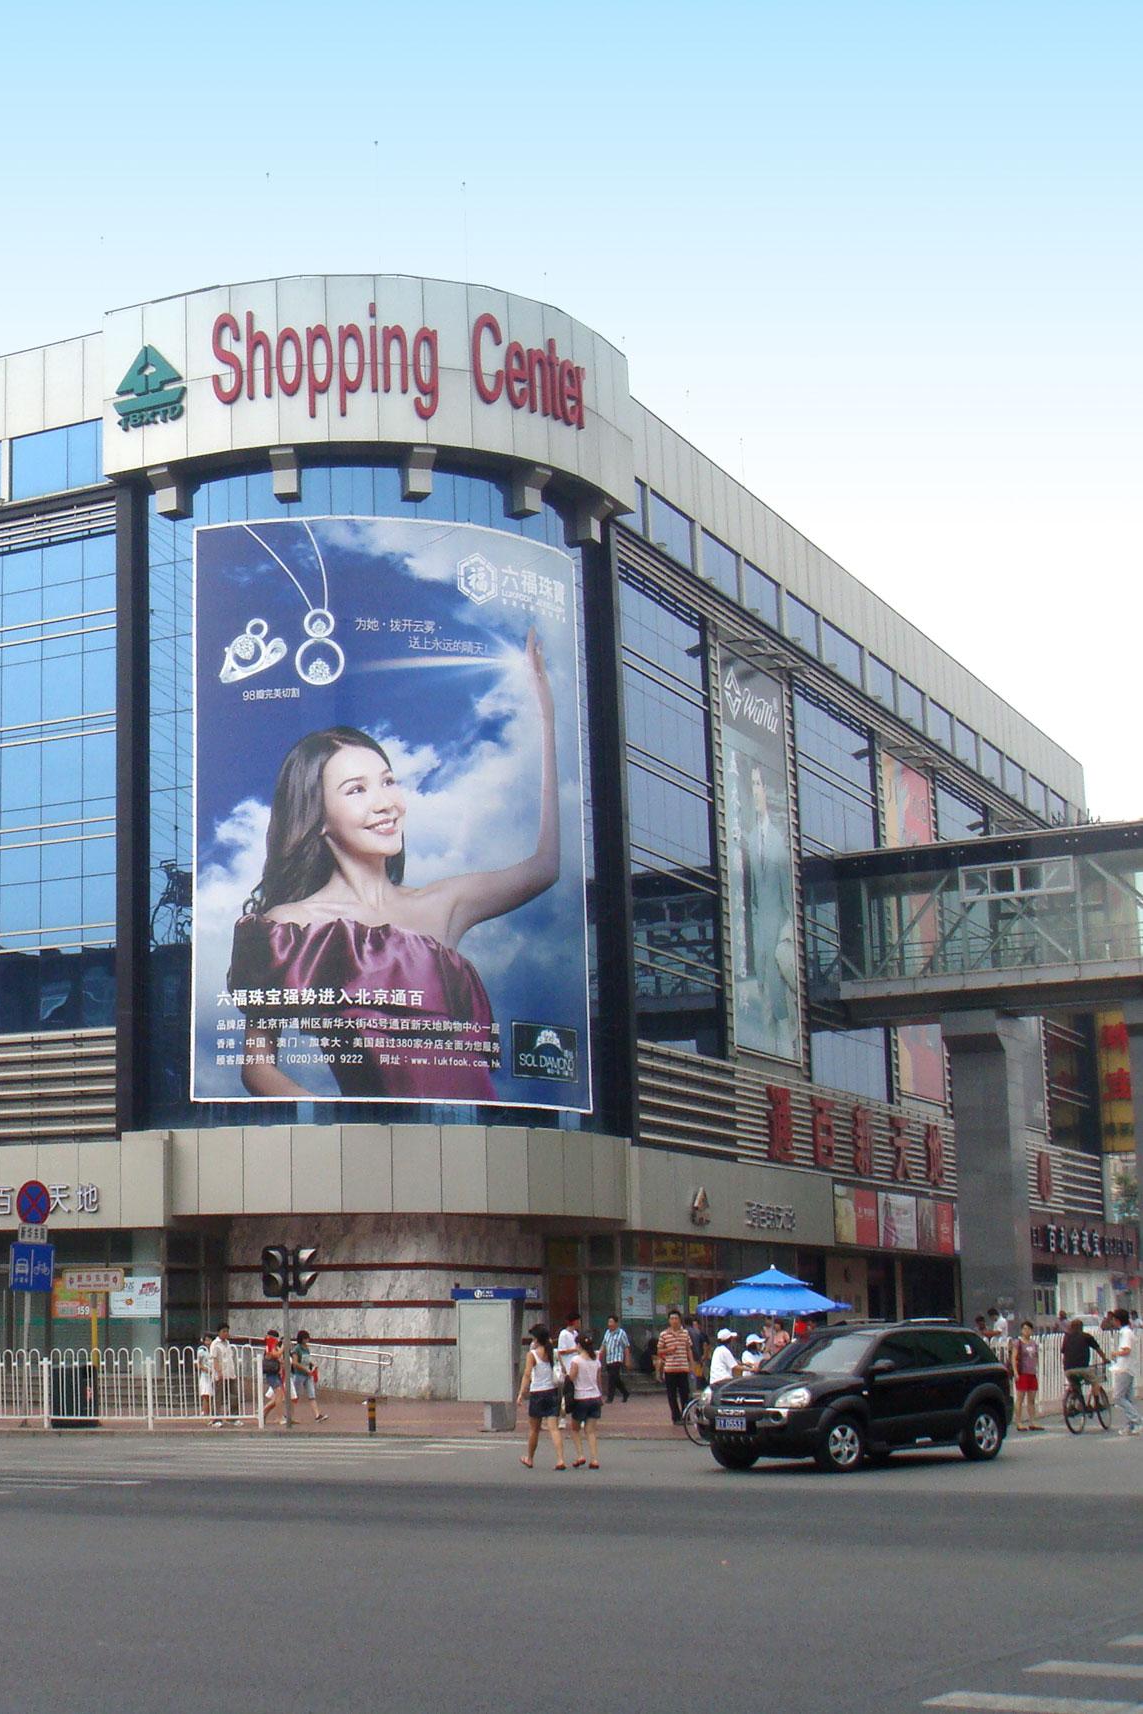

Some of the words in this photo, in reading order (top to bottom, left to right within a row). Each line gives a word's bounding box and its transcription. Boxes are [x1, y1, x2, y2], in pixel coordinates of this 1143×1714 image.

[212, 302, 439, 420] Shopping
[472, 312, 587, 430] Center
[216, 988, 425, 1007] 六福珠宝强势进入北京通百
[340, 1054, 363, 1064] 9222
[519, 1053, 538, 1067] SOL
[77, 1305, 90, 1315] 159
